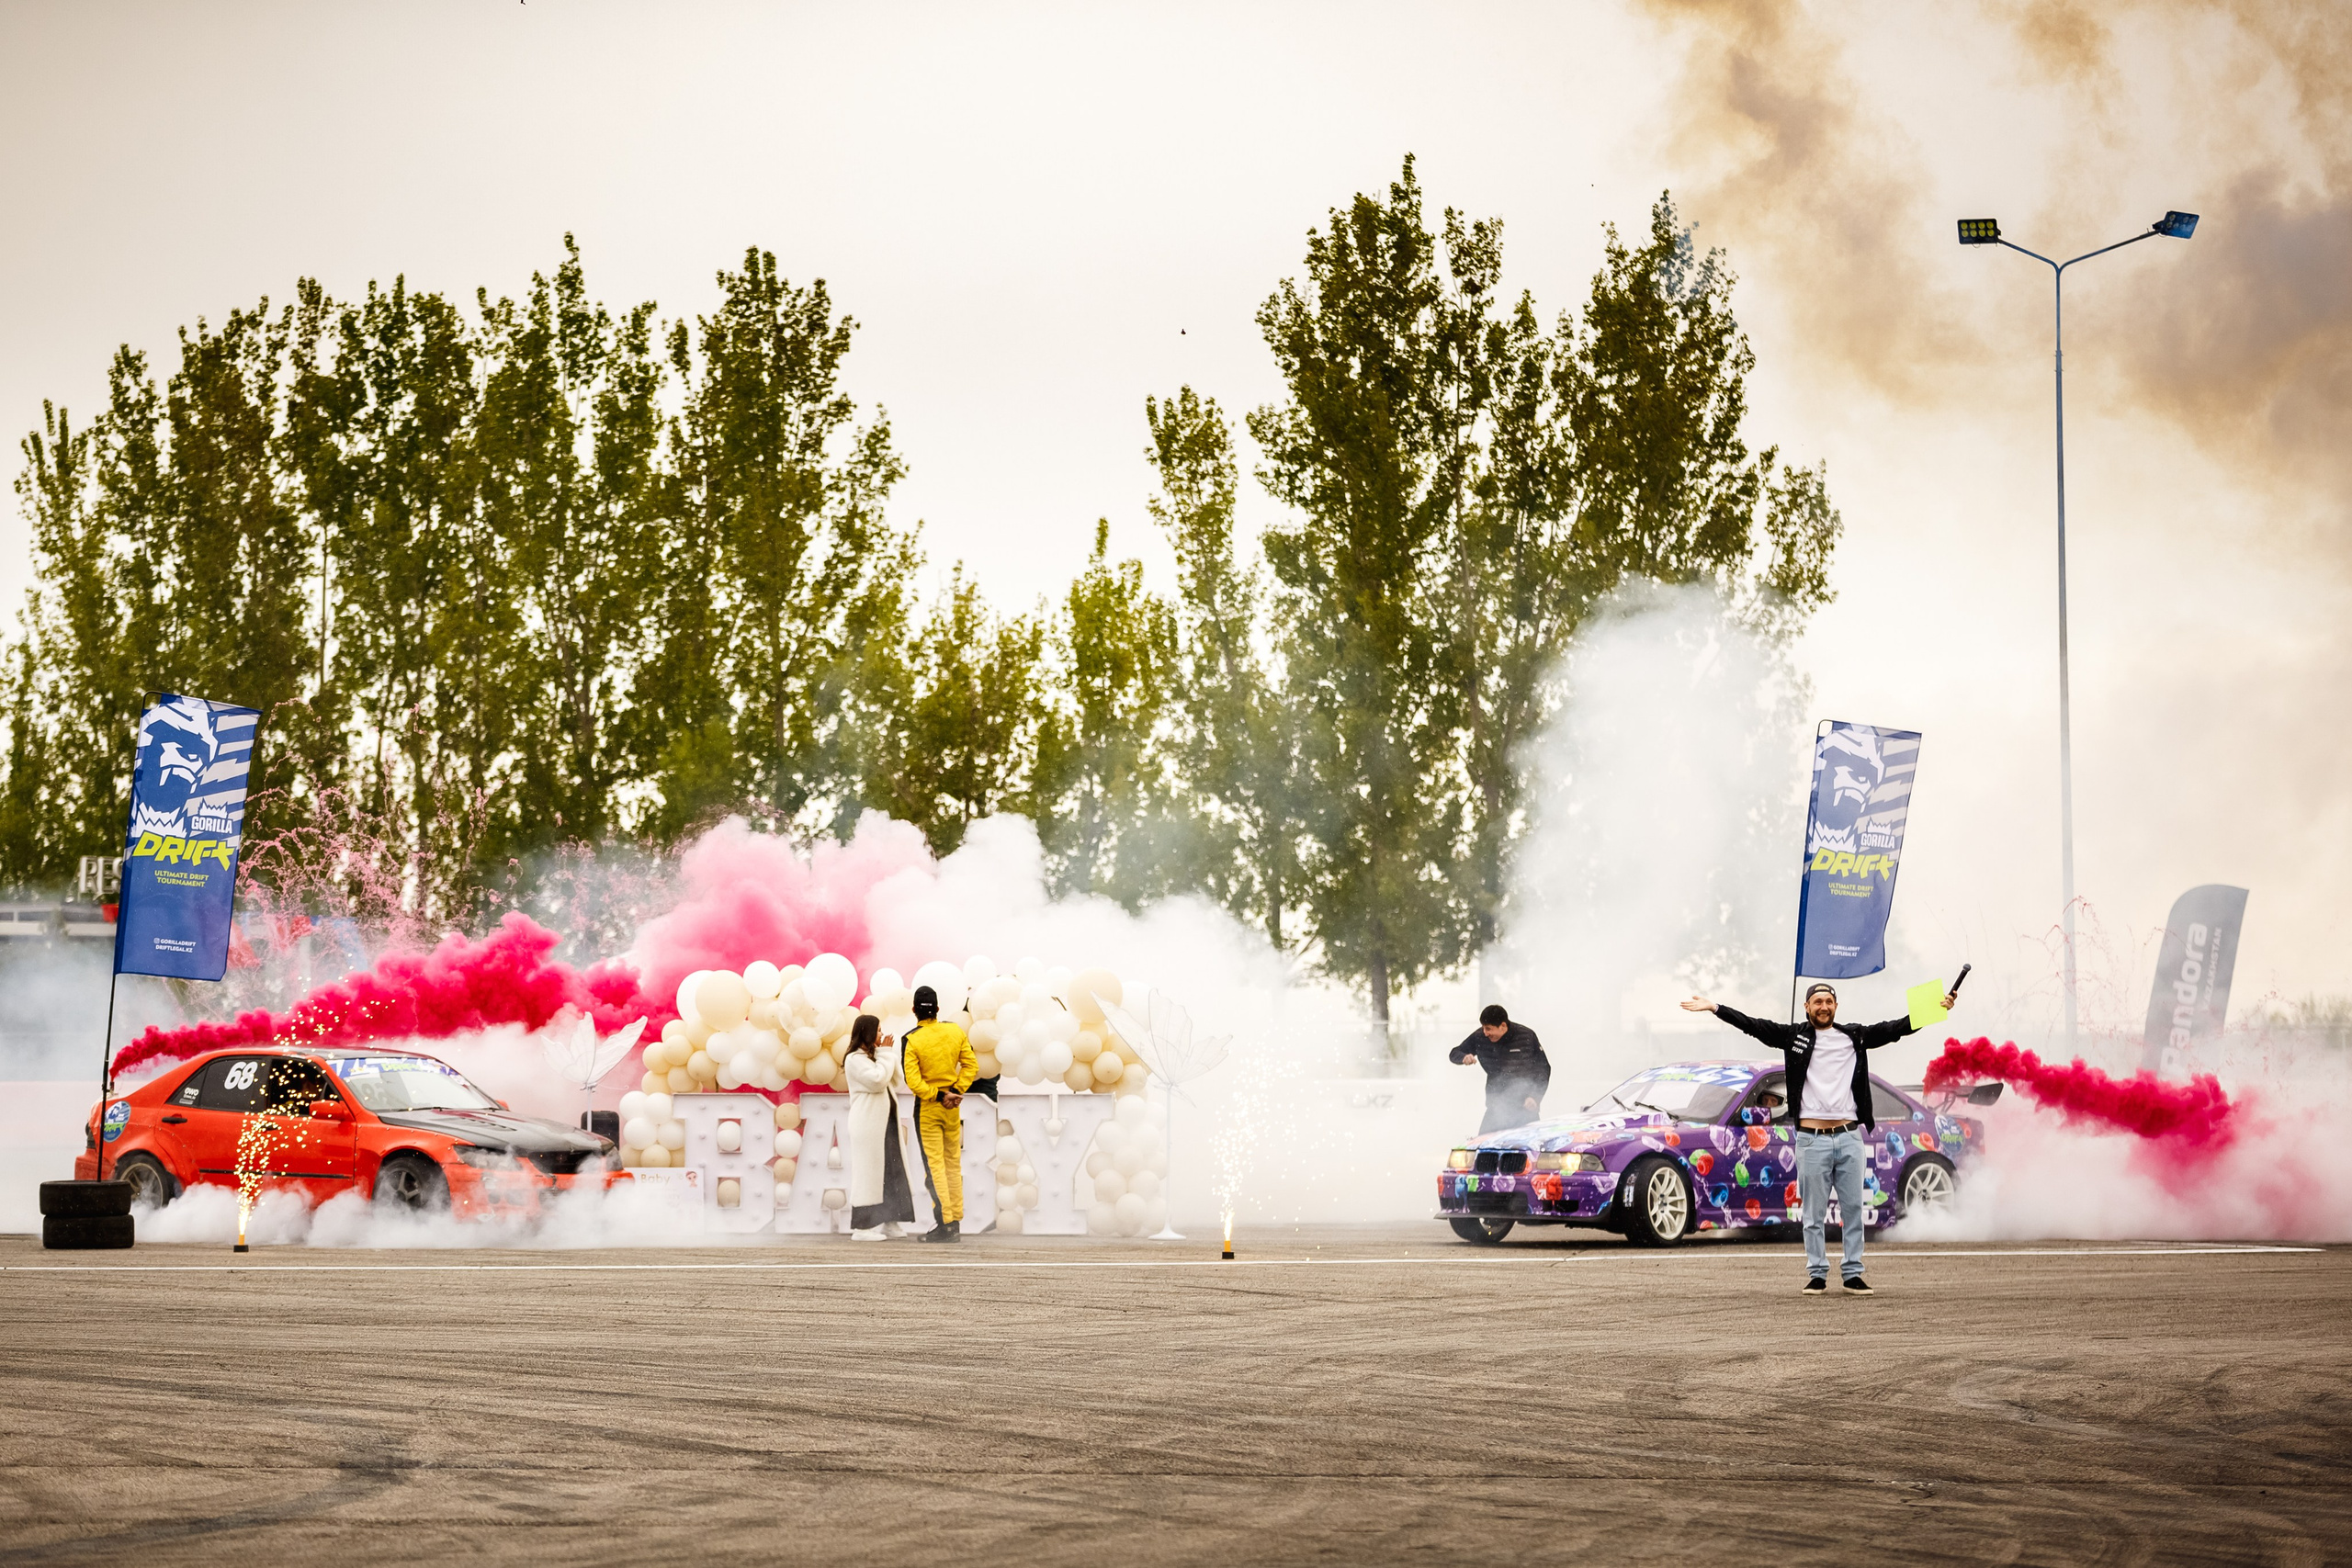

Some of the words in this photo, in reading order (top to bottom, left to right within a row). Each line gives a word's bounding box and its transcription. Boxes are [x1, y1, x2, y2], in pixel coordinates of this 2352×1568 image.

[191, 816, 233, 834] GORILLA
[1860, 833, 1895, 849] GORILLA
[131, 831, 235, 872] DRIFT
[1810, 847, 1895, 882] DRIFT
[154, 870, 188, 880] ULTIMATE
[189, 873, 209, 881] DRIFT
[156, 876, 206, 888] TOURNAMENT
[1828, 882, 1856, 891] ULTIMATE
[1857, 884, 1874, 892] DRIFT
[1830, 889, 1871, 898] TOURNAMENT
[155, 944, 193, 953] DRIFTLEGAL.KZ
[2159, 922, 2208, 1078] Pandora
[224, 1061, 258, 1090] 68
[672, 1093, 1114, 1235] BABY
[640, 1173, 671, 1185] Baby
